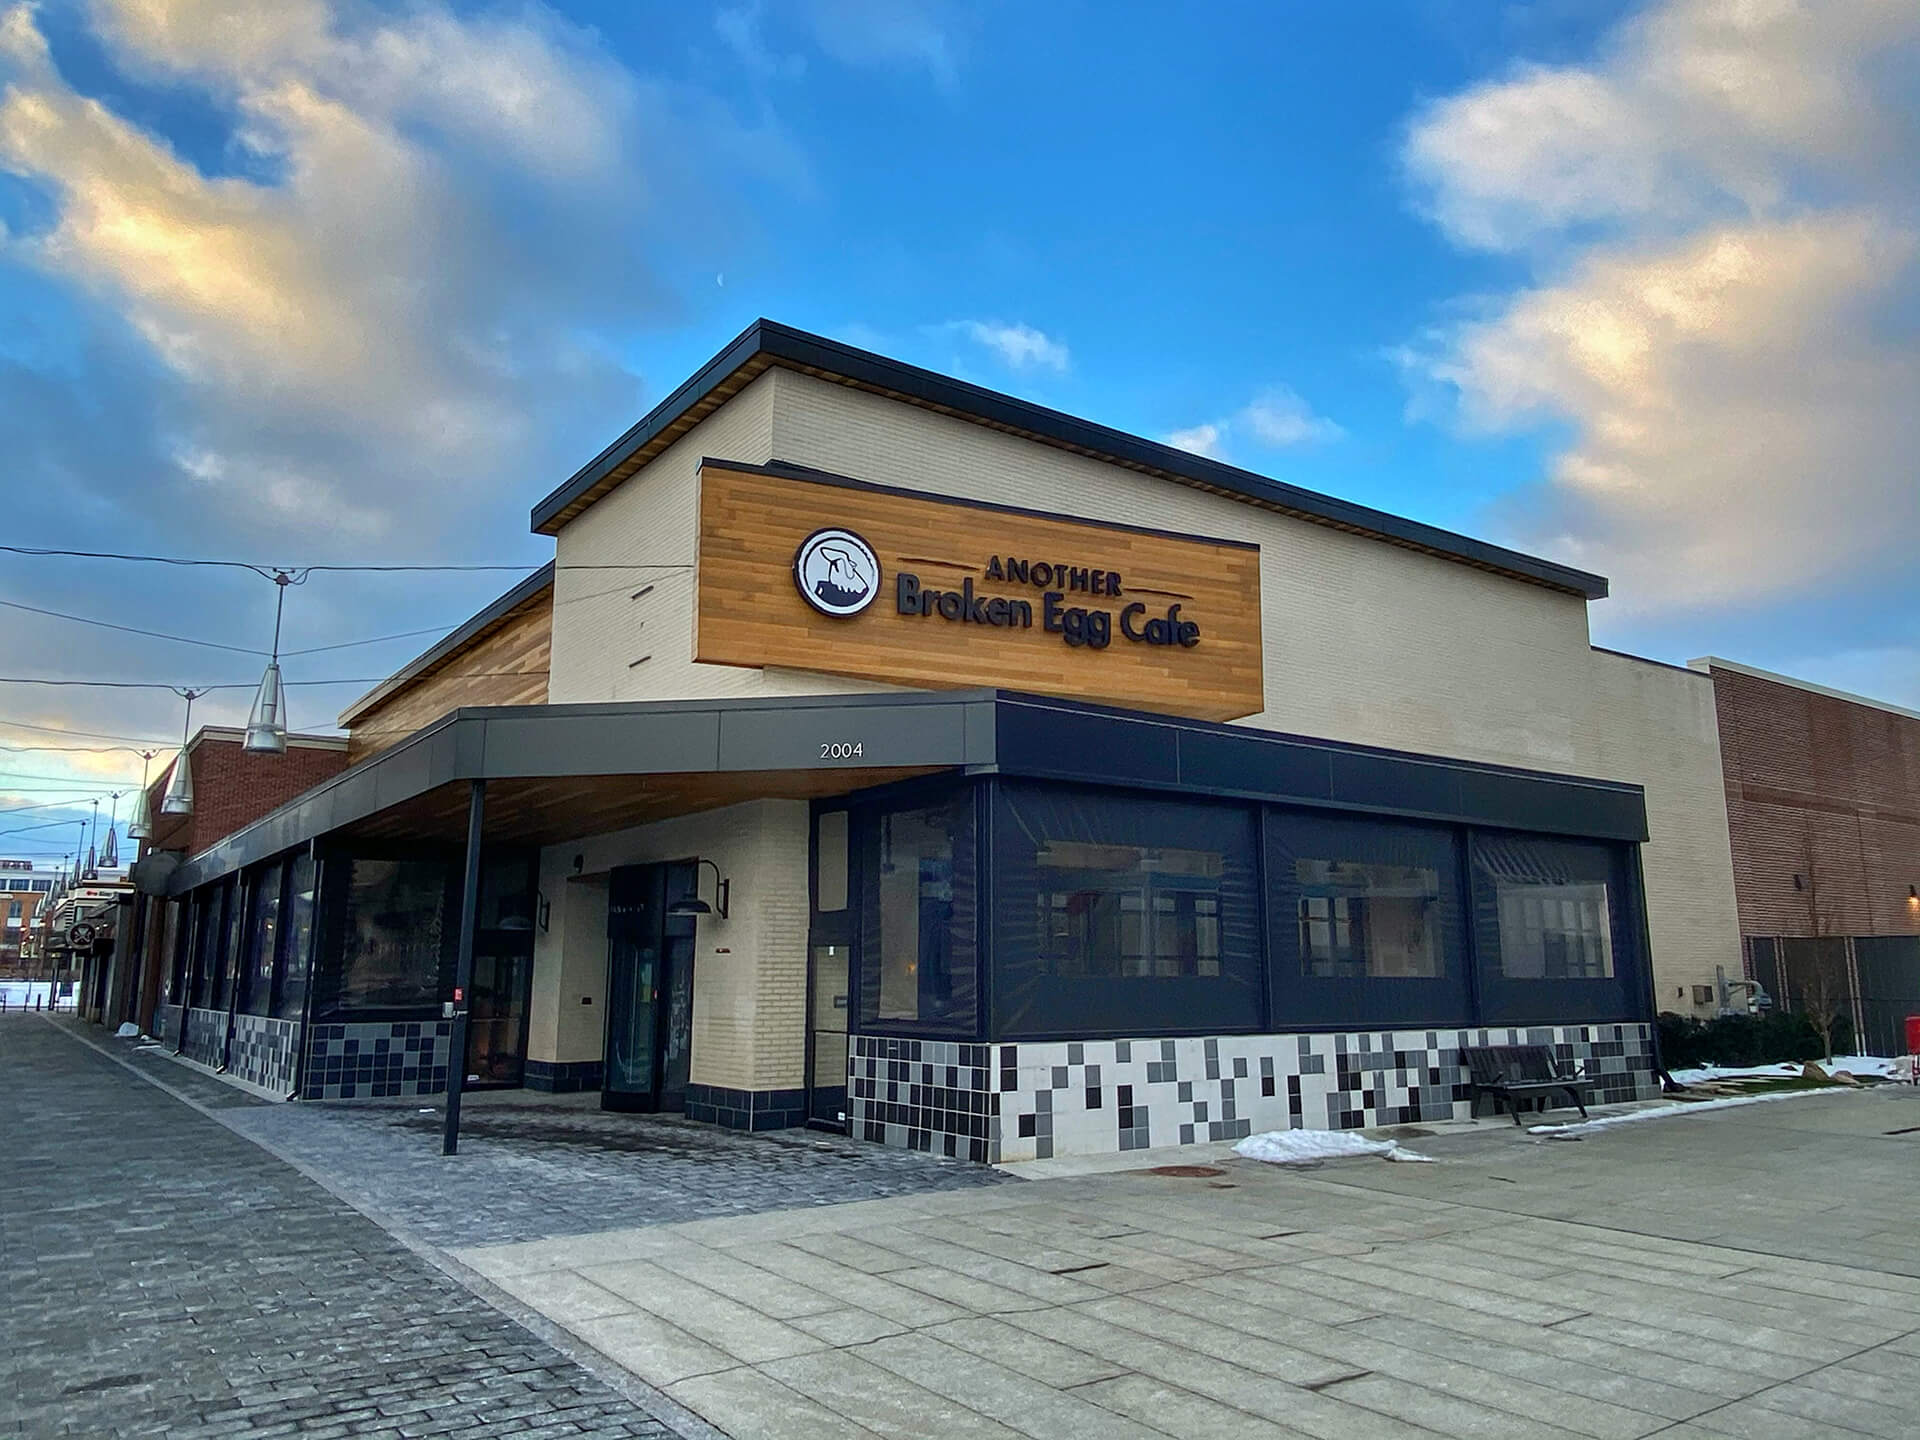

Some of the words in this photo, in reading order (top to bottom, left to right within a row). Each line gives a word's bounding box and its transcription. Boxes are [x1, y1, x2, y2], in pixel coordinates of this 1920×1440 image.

[984, 555, 1122, 597] ANOTHER
[897, 572, 1032, 629] Broken
[1043, 591, 1111, 649] Egg
[1120, 602, 1200, 648] Cafe
[820, 742, 863, 759] 2004
